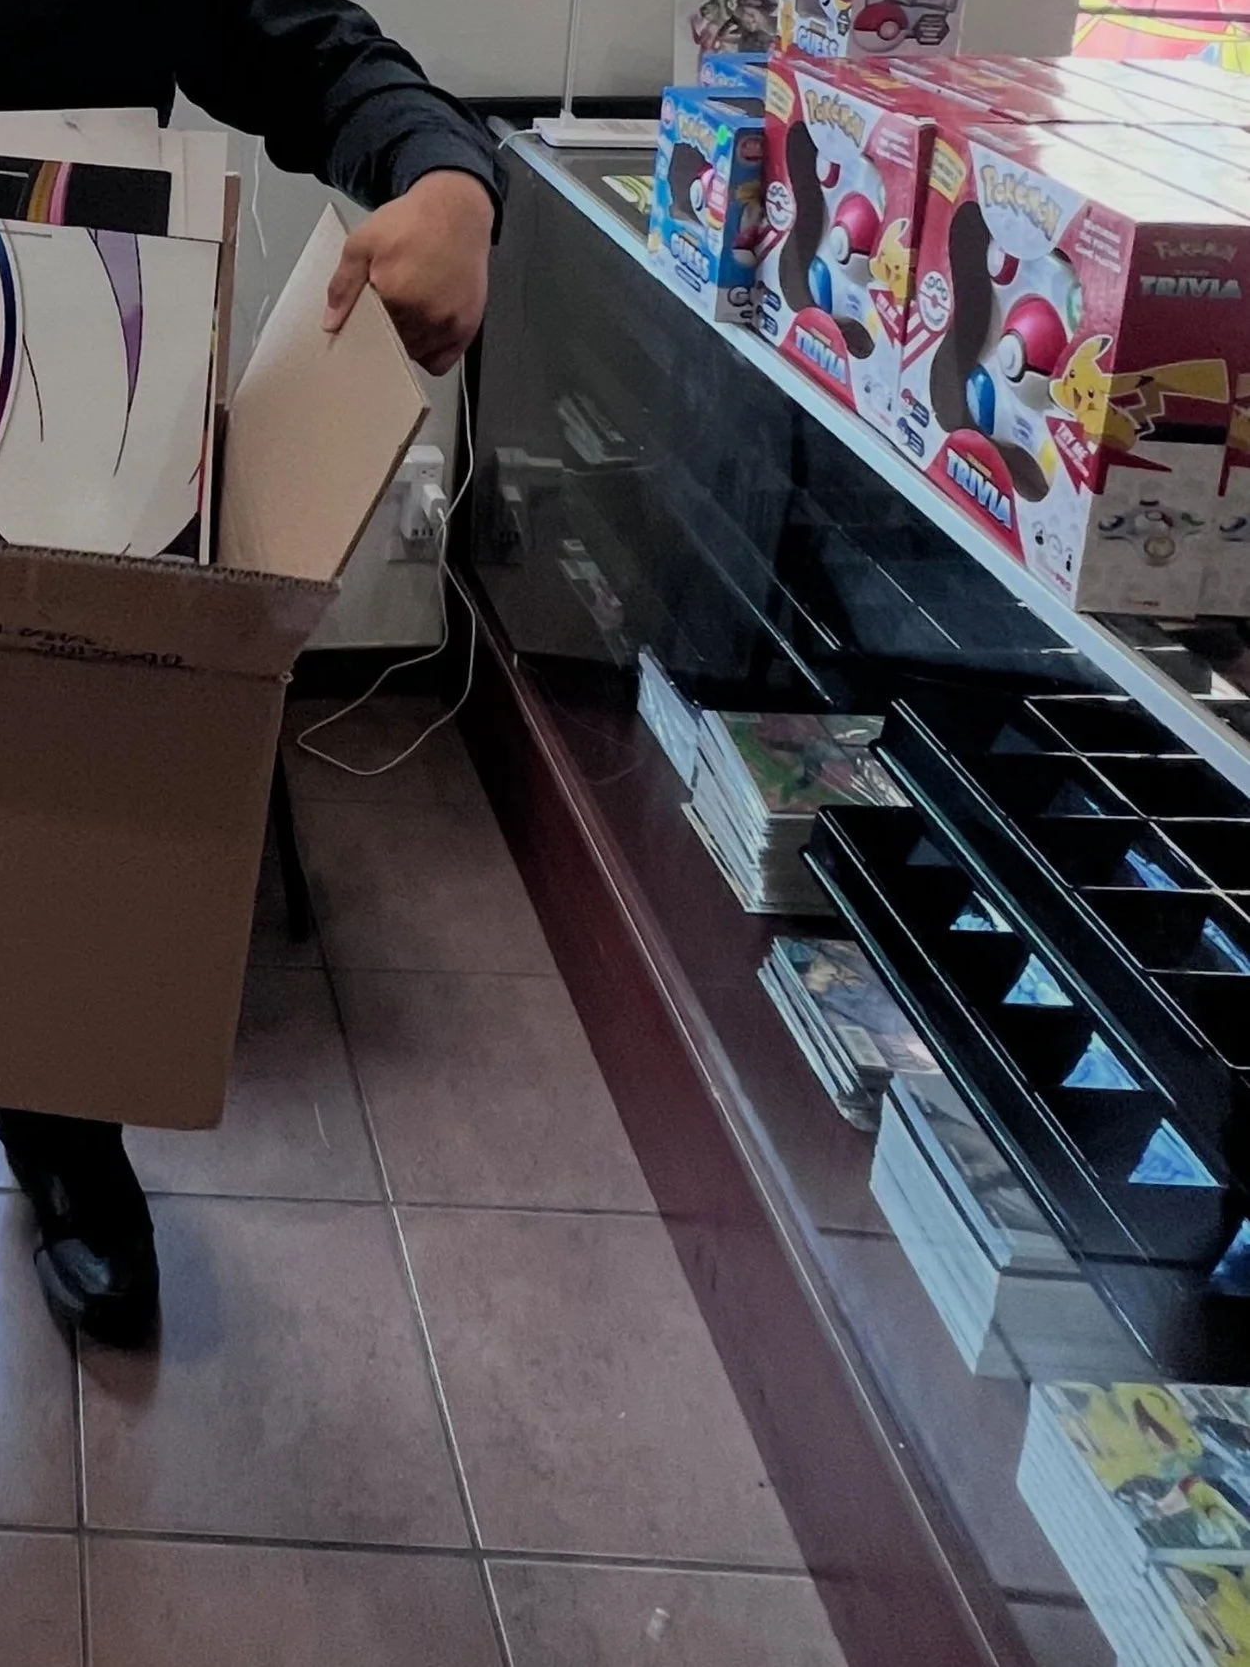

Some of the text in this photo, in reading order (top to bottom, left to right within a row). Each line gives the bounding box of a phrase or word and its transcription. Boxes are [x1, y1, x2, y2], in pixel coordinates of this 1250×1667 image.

[805, 89, 866, 148] Pokémon
[980, 165, 1064, 242] Pokémon
[1139, 275, 1243, 300] TRIVIA
[795, 324, 848, 385] TRIVIA
[946, 447, 1012, 530] TRIVIA
